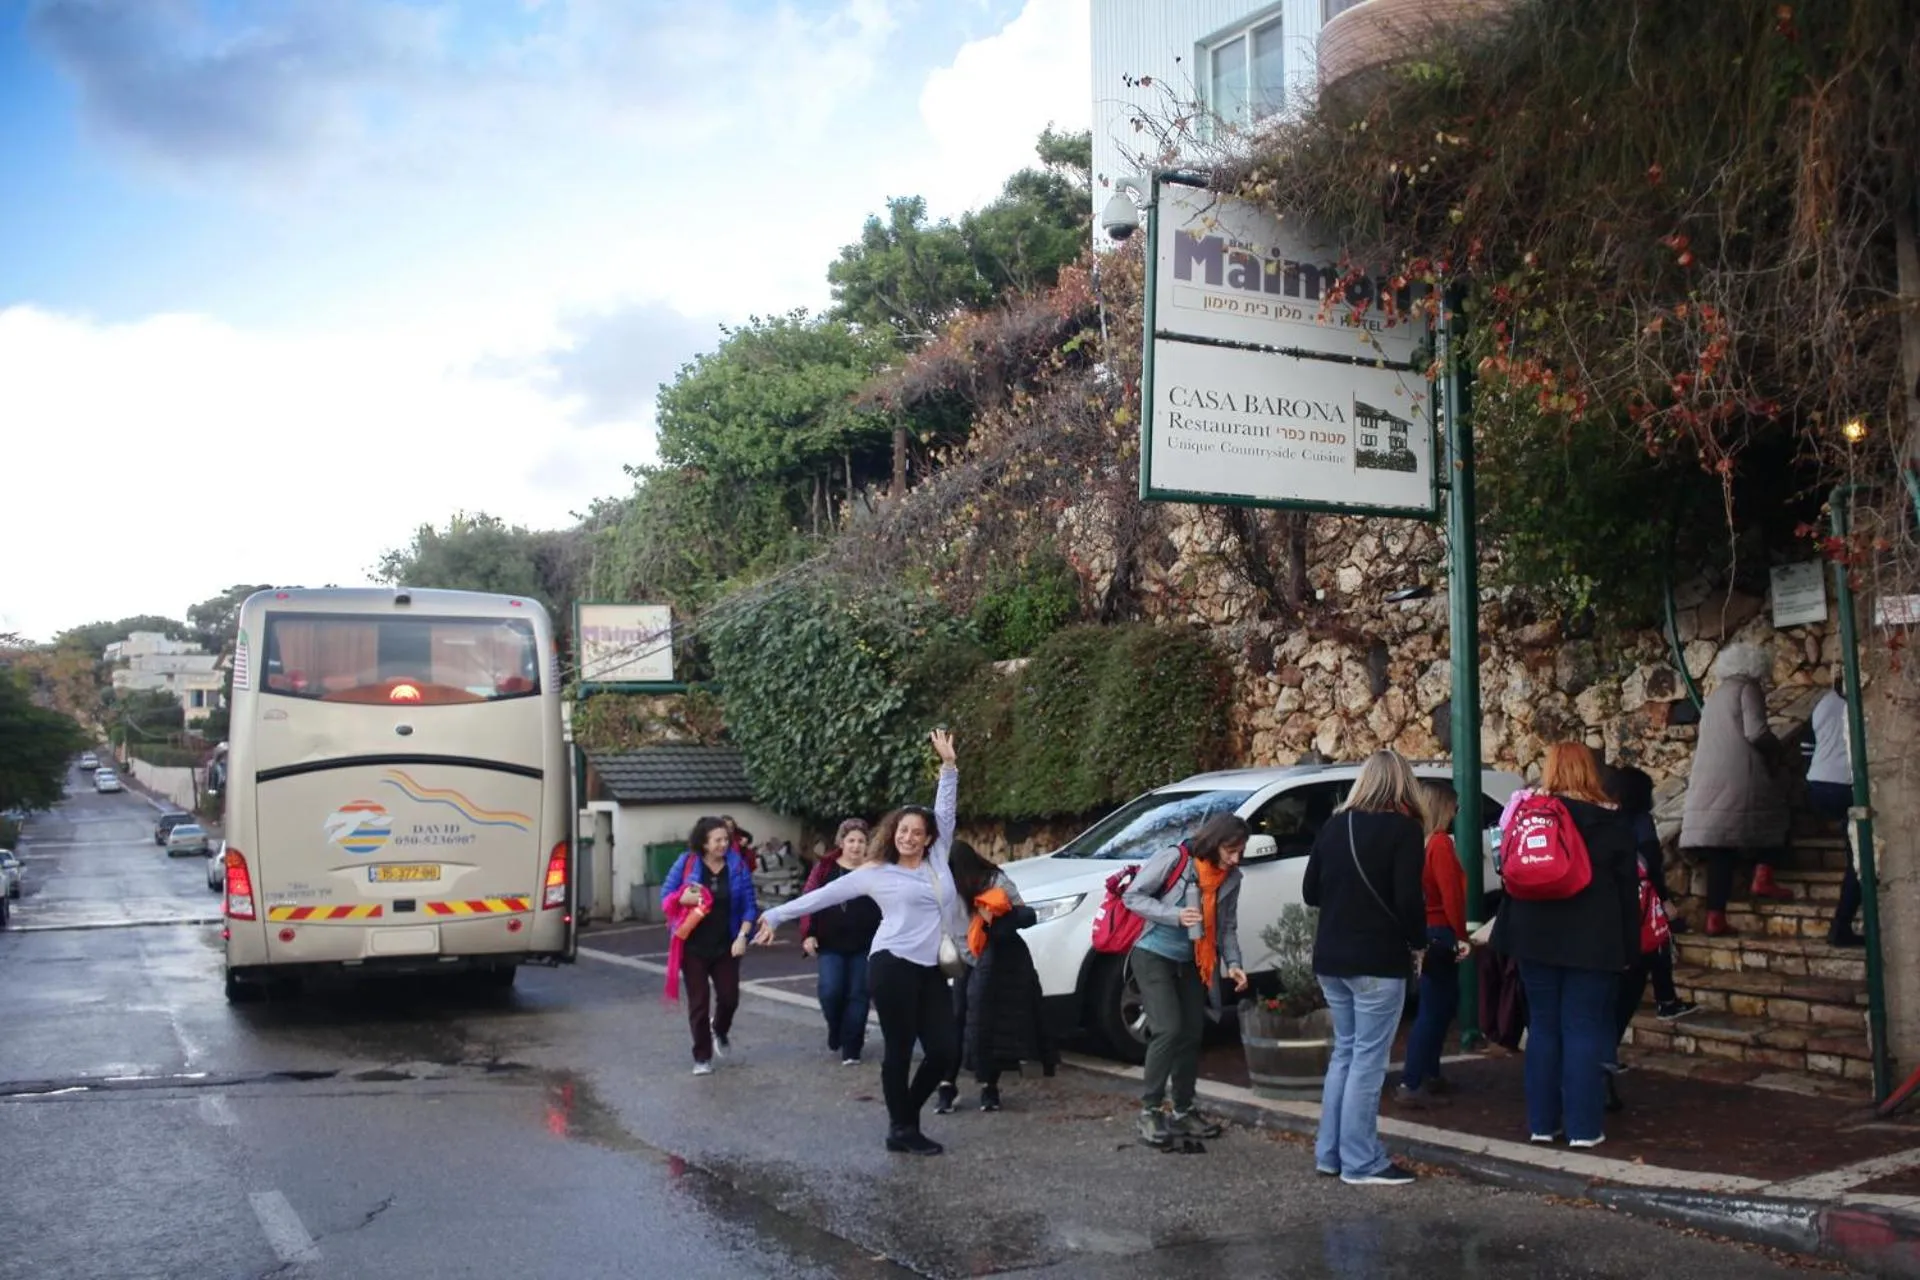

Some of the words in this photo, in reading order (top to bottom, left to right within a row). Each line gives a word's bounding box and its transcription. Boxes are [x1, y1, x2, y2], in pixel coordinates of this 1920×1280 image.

[1203, 295, 1239, 311] מימון
[1244, 302, 1269, 316] בית
[1275, 304, 1302, 319] מלון
[1340, 316, 1384, 333] HTEL
[1169, 386, 1237, 411] CASA
[1244, 394, 1345, 424] BARONA
[1169, 411, 1270, 437] Restaurant
[1275, 426, 1305, 441] כפרי
[1310, 430, 1346, 445] מטבח
[1168, 436, 1216, 455] Unique
[1220, 441, 1297, 461] Countryside
[1301, 449, 1346, 464] Cuisine
[413, 824, 460, 834] DAVID
